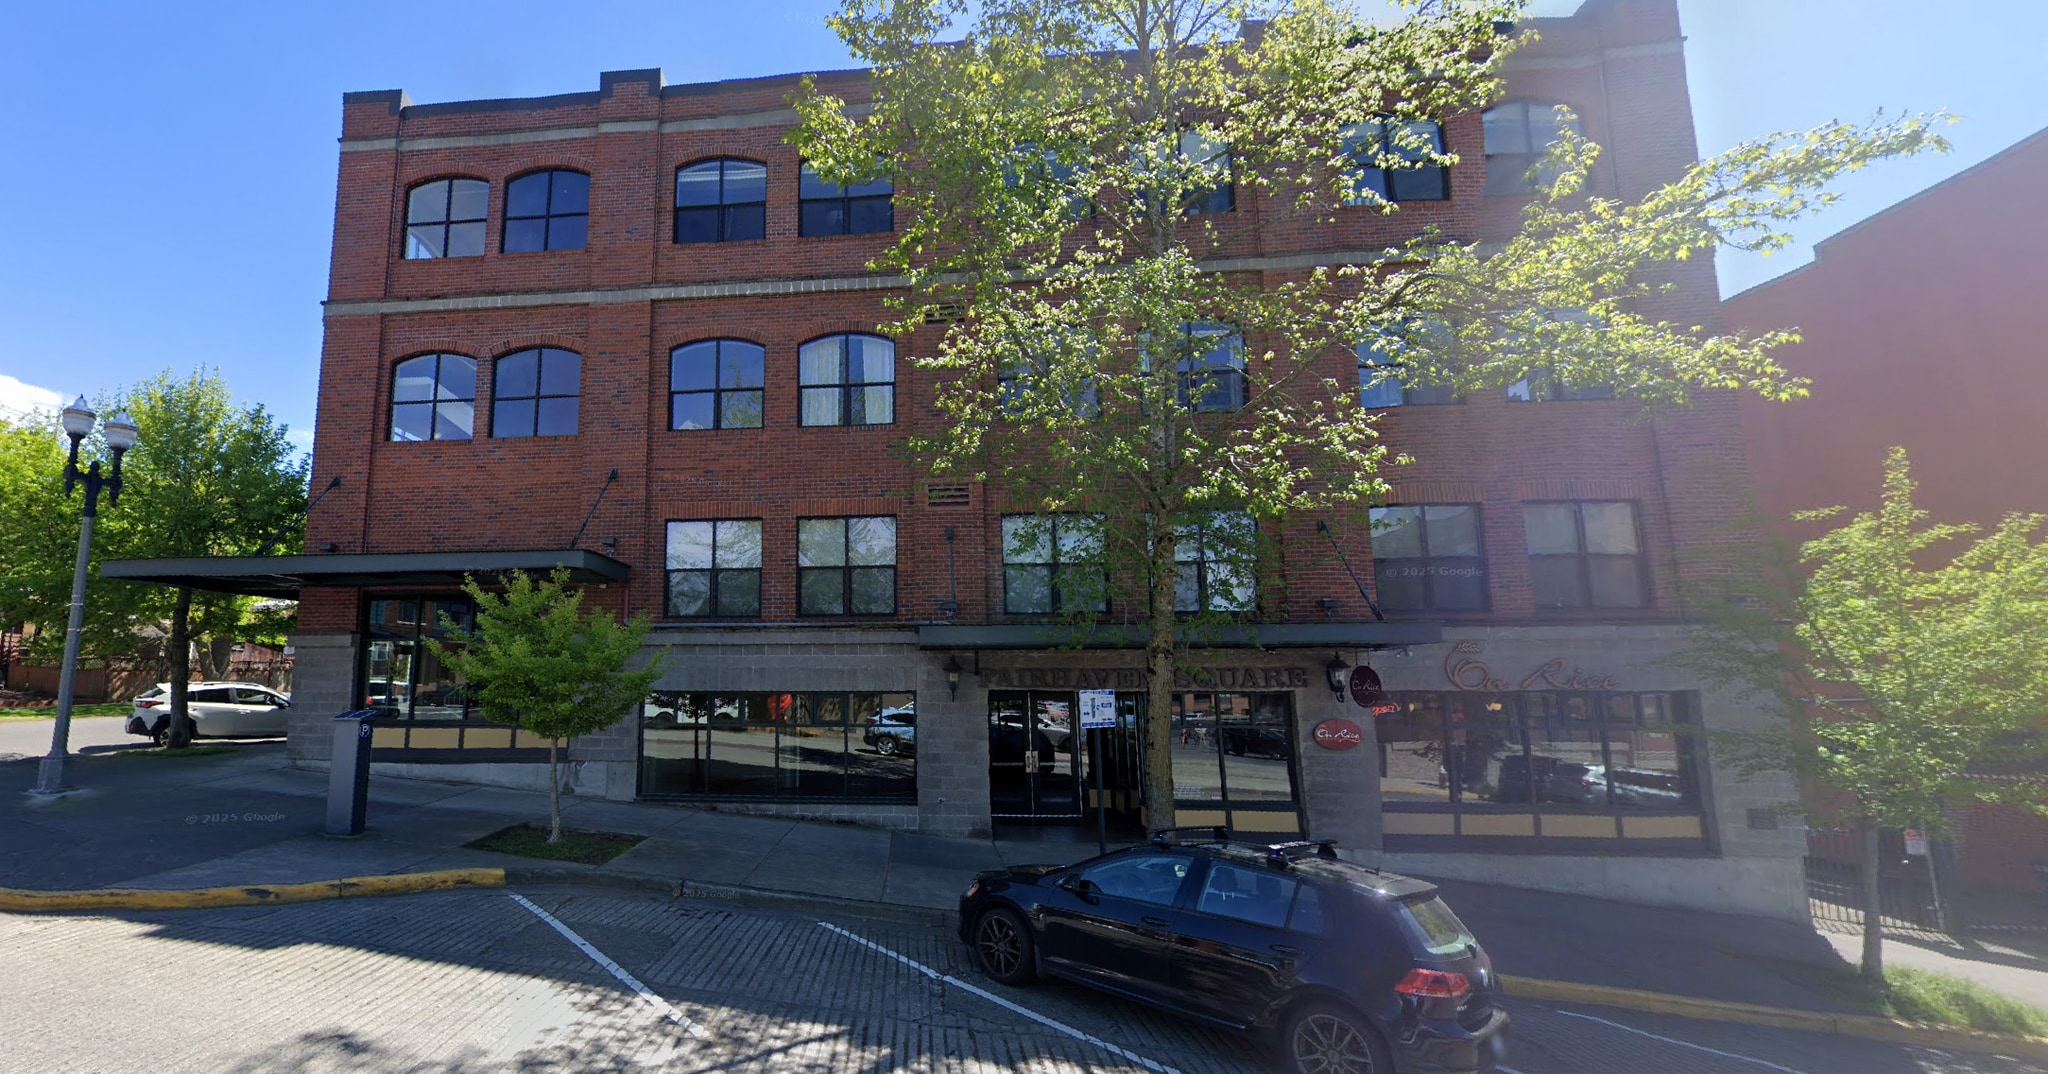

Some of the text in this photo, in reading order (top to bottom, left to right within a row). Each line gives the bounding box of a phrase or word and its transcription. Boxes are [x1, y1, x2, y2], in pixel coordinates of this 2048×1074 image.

[1173, 666, 1308, 689] SQUARE
[1521, 657, 1622, 691] Rice
[1362, 680, 1380, 691] Rice
[1317, 728, 1360, 739] On Rice
